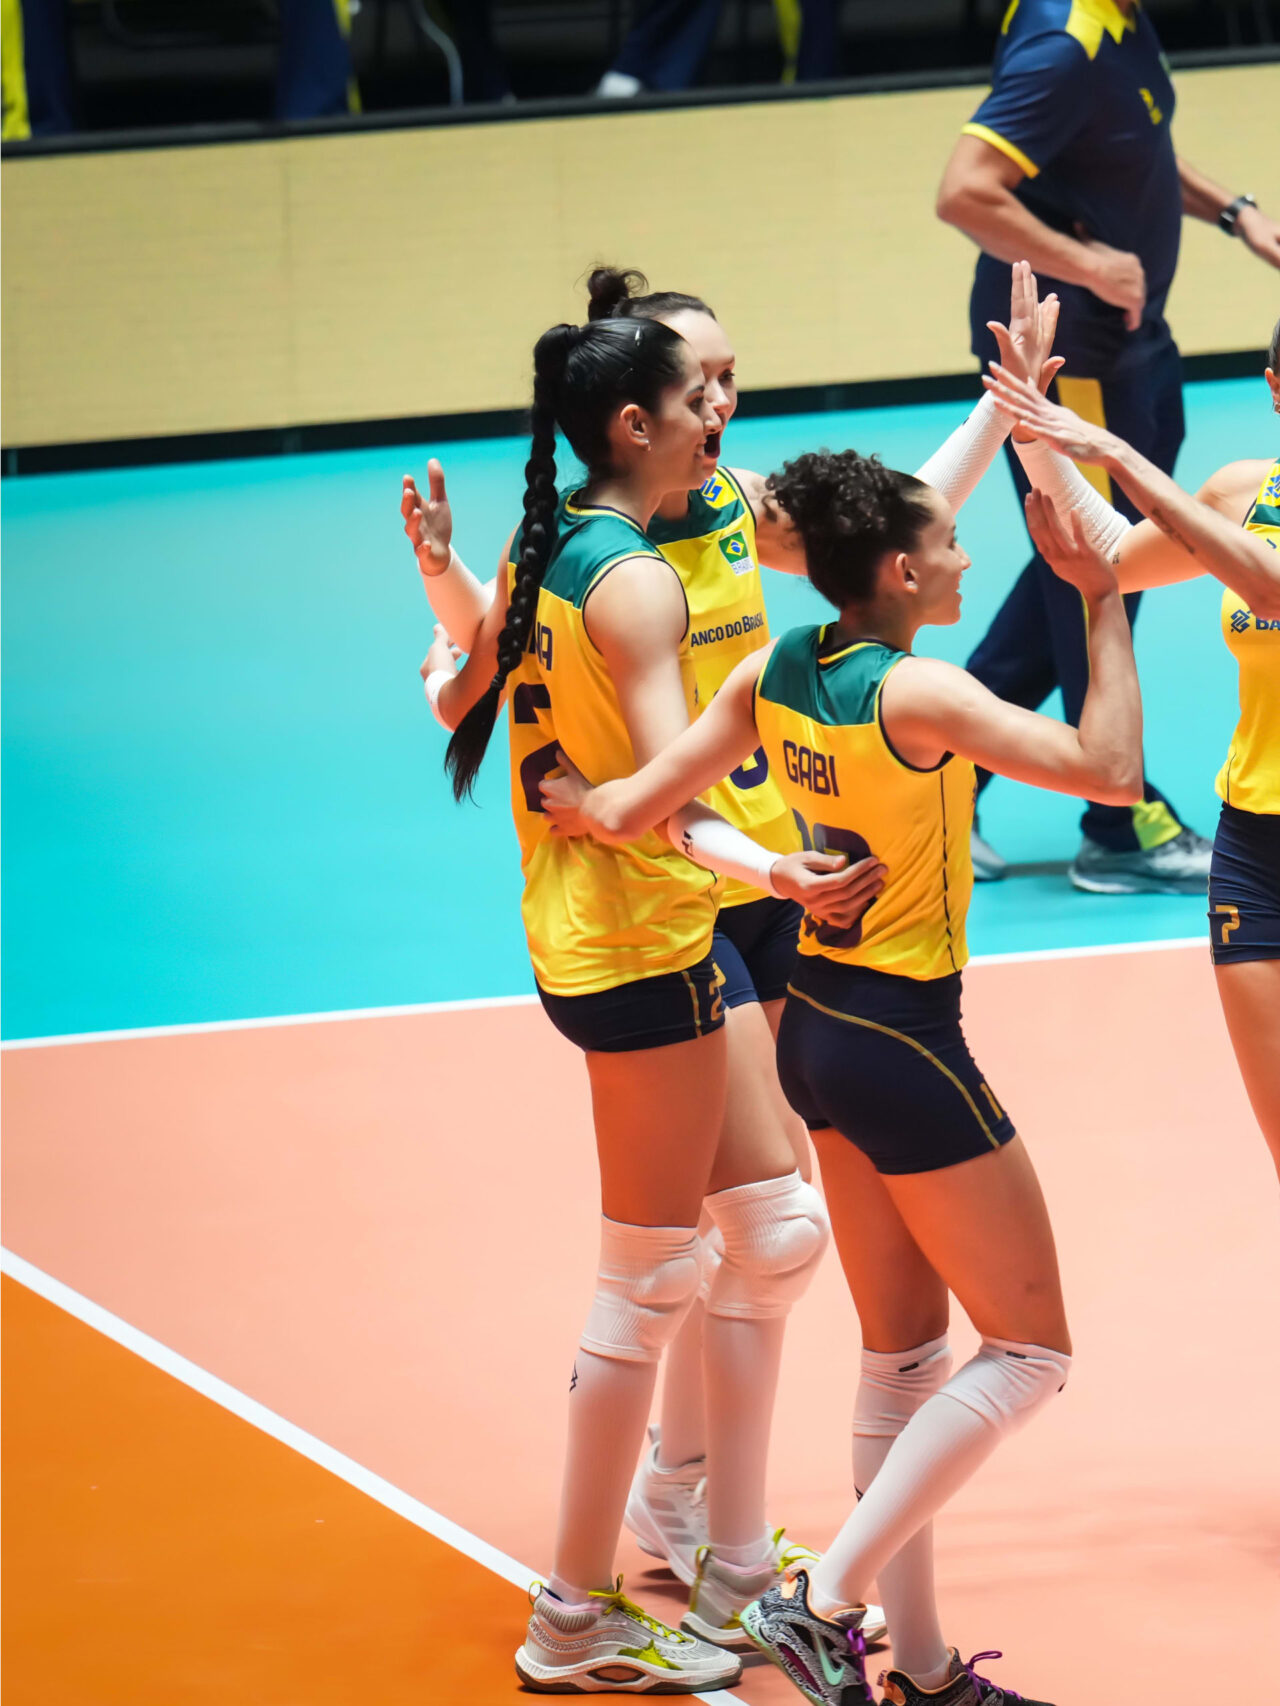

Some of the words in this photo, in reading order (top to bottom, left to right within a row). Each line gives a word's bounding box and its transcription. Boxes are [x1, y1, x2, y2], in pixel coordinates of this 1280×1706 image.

[690, 626, 725, 647] ANCO
[725, 621, 742, 638] DO
[783, 739, 840, 797] GABI
[1215, 904, 1240, 945] 7
